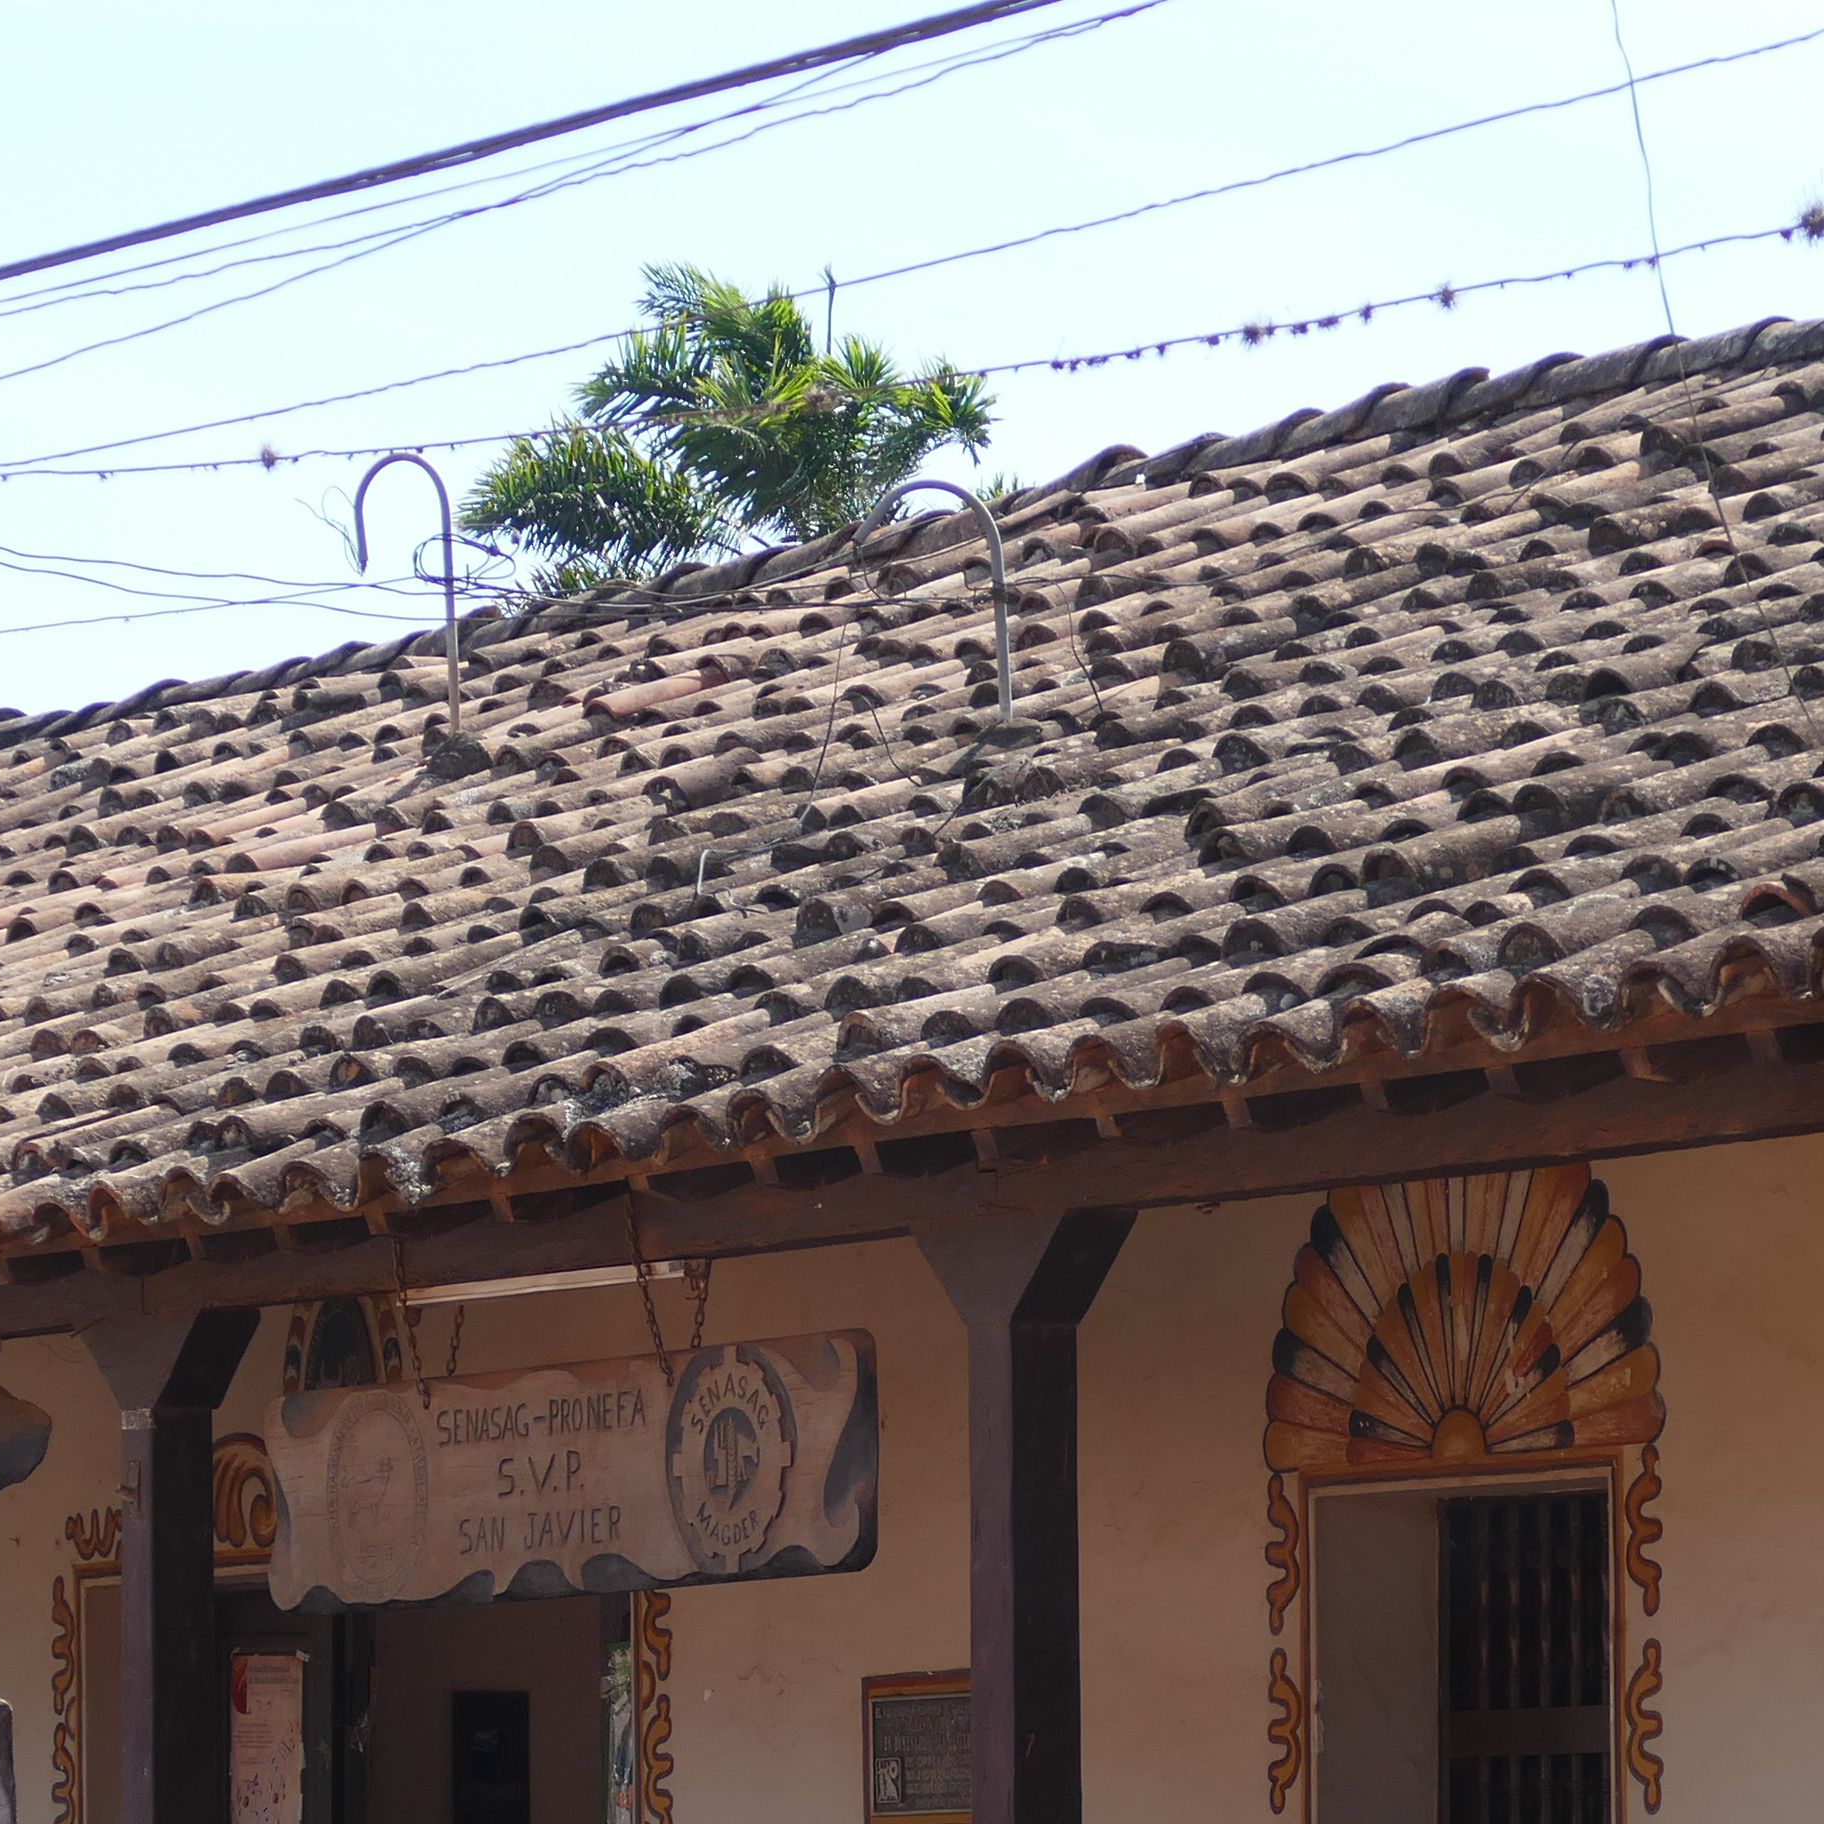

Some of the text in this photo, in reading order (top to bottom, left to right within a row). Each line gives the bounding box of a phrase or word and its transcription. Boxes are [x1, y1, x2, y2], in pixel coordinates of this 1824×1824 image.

[691, 1372, 769, 1434] SENASAG
[498, 1449, 584, 1497] S.V.P.
[459, 1505, 621, 1555] SAN JAVIER
[696, 1501, 758, 1546] MAGDER
